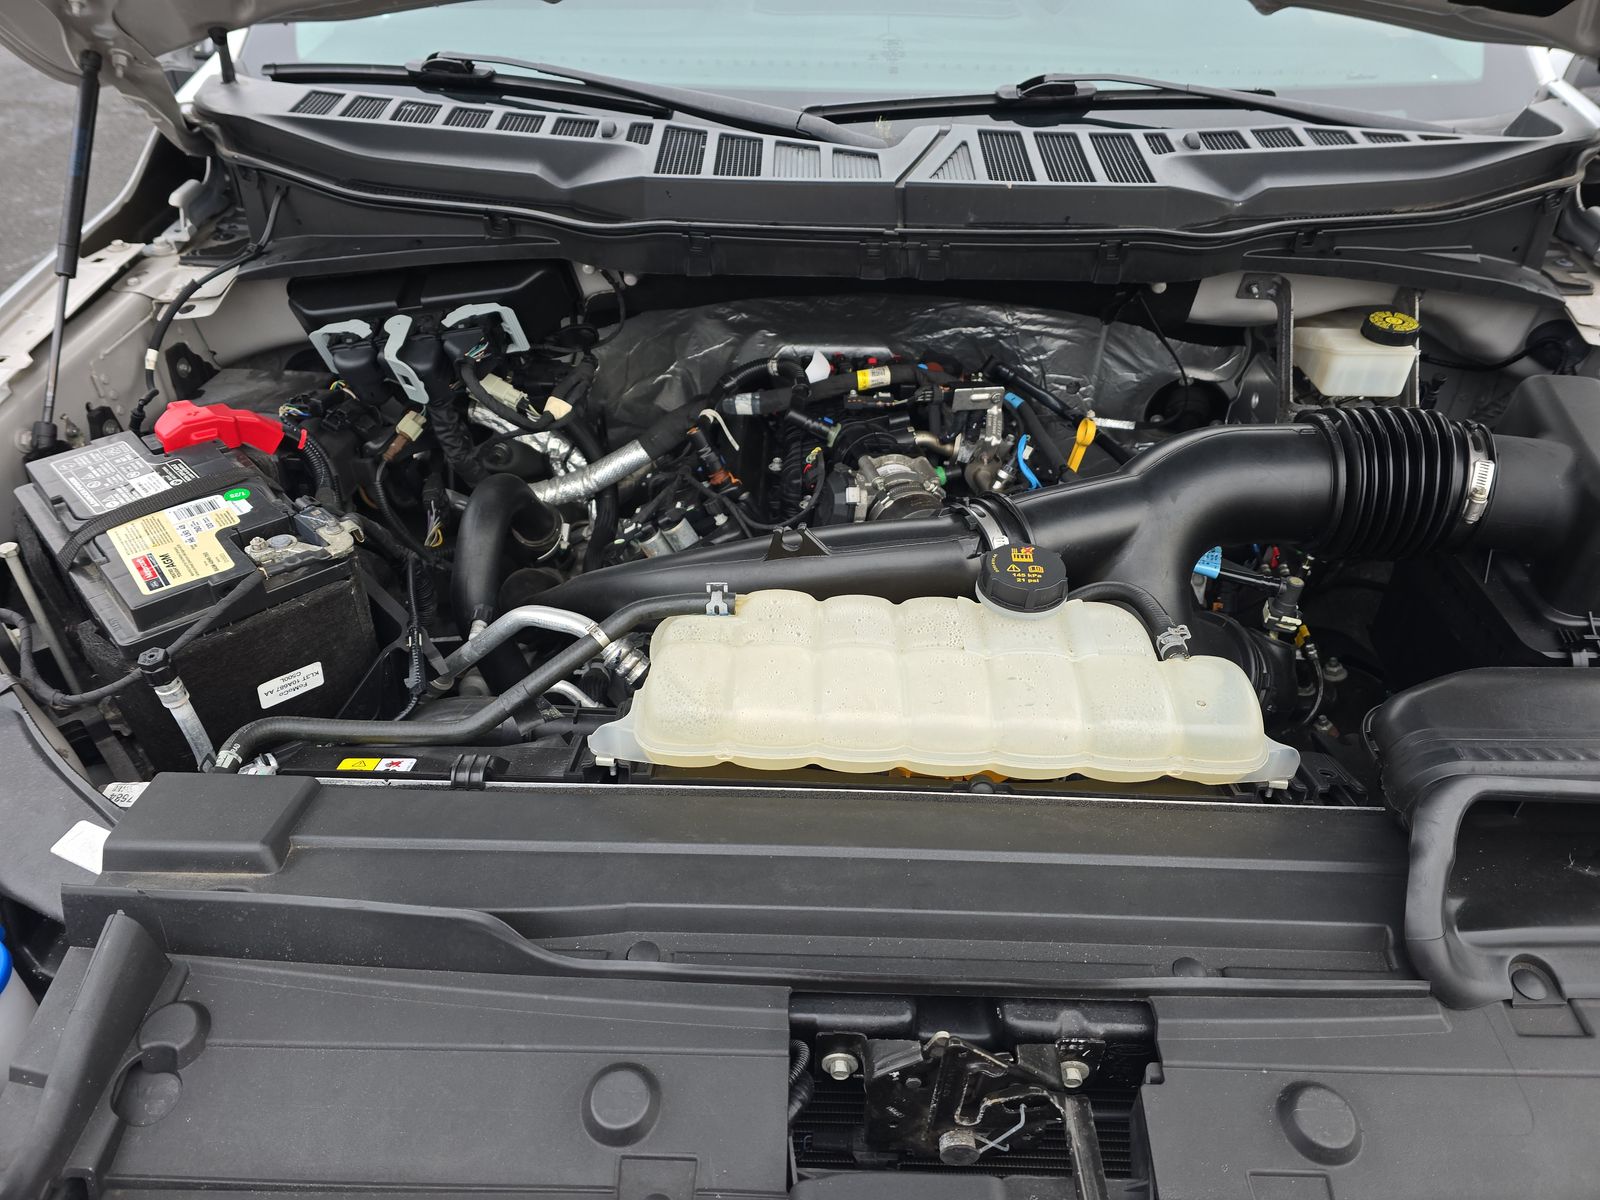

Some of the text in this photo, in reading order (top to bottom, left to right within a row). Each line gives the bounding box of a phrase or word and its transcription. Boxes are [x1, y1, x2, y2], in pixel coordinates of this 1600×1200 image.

[159, 552, 177, 569] AGM
[264, 689, 275, 697] AA
[279, 682, 308, 697] FoMoCo
